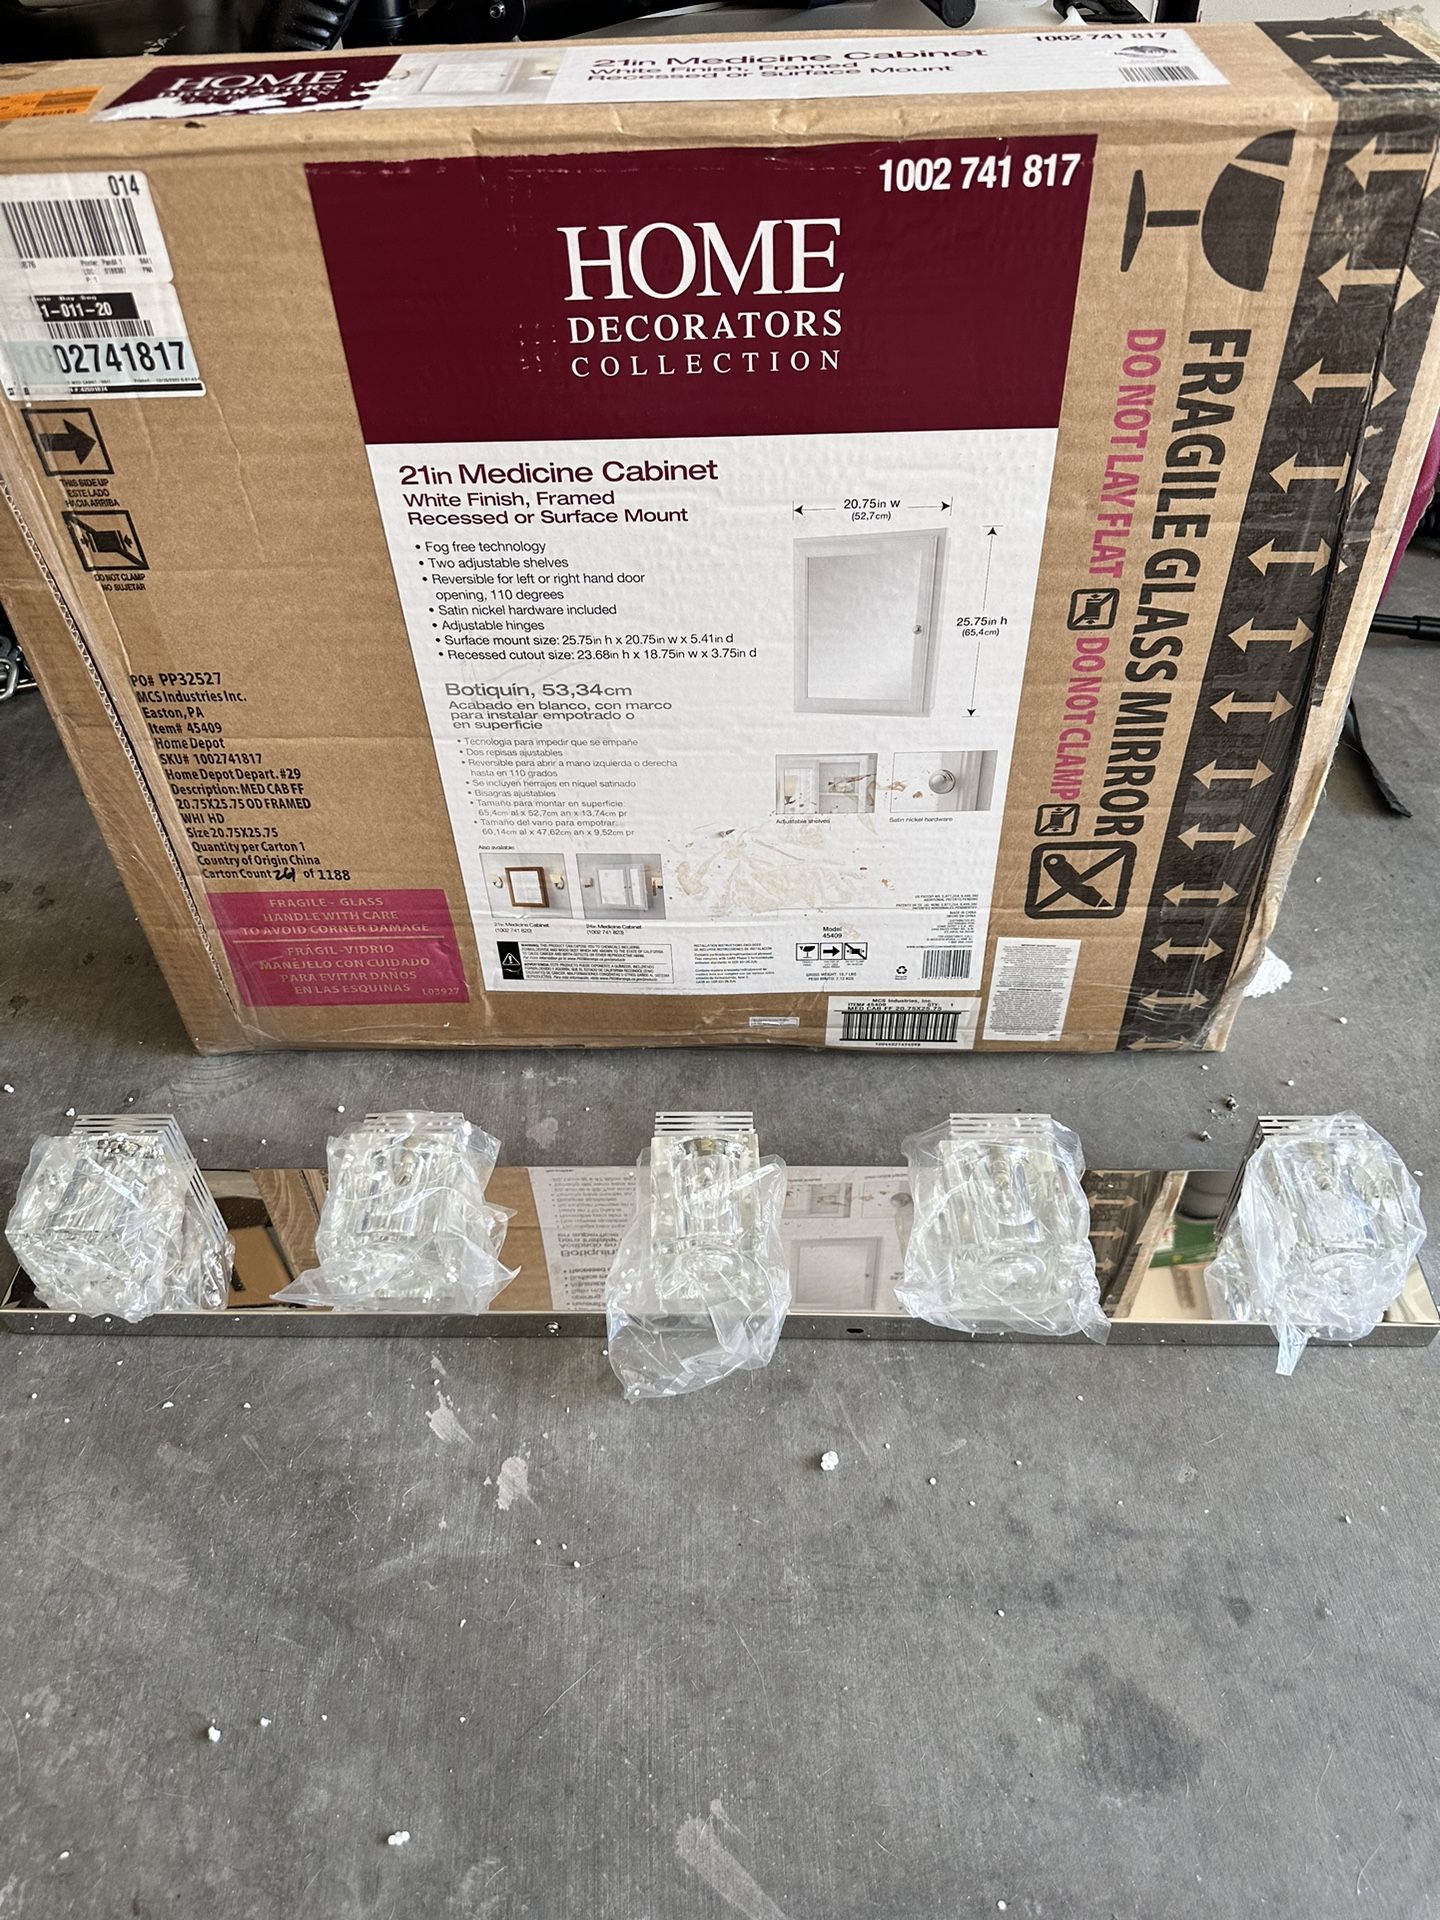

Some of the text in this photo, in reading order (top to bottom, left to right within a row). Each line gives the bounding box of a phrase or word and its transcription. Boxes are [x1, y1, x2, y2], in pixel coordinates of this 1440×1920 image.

[667, 55, 831, 64] Medicine
[844, 50, 987, 59] Cabinet
[169, 70, 347, 90] HOME
[880, 154, 1080, 191] 1002 741 817
[108, 175, 139, 196] 014
[557, 218, 844, 300] HOME
[568, 310, 841, 343] DECORATORS
[572, 350, 839, 376] COLLECTION
[1088, 329, 1167, 580] DO NOT LAY FLAT
[400, 460, 718, 484] 21in Medicine Cabinet
[403, 490, 614, 508] White Finish, Framed
[844, 499, 886, 509] 20.75in
[408, 508, 688, 525] Recessed or Surface Mount
[852, 512, 891, 522] (52,7cm)
[425, 541, 546, 555] Fog free technology
[428, 557, 568, 570] Two adjustable shelves
[432, 574, 494, 584] Reversible
[497, 574, 513, 584] for
[516, 573, 534, 584] left
[554, 574, 580, 586] right
[583, 573, 613, 583] hand
[617, 573, 645, 583] door
[1093, 329, 1252, 839] FRAGILE GLASS MIRROR
[436, 589, 564, 602] opening, 110 degrees
[438, 604, 616, 615] Satin nickel hardware included
[442, 620, 544, 632] Adjustable hinges
[957, 617, 996, 626] 25.75in
[962, 628, 999, 637] (65,4cm)
[445, 635, 489, 645] Surface
[493, 636, 530, 645] mount
[562, 635, 601, 645] 25.75in
[605, 635, 612, 644] h
[626, 634, 665, 644] 20.75in
[691, 634, 723, 644] 5.41in
[726, 633, 733, 643] d
[130, 672, 220, 686] PO# PP32527
[136, 690, 246, 702] MCS Industries Inc.
[446, 683, 632, 699] Botiquín, 53,34cm
[449, 701, 512, 710] Acabado
[539, 701, 590, 710] blanco,
[142, 707, 204, 719] Easton, PA
[451, 712, 484, 720] para
[488, 711, 538, 719] instalar
[543, 711, 621, 721] empotrado
[1052, 636, 1110, 800] DO NOT CLAMP
[148, 722, 222, 734] Item# 45409
[475, 720, 542, 730] superficie
[154, 738, 225, 751] Home Depot
[536, 739, 568, 747] impedir
[159, 753, 261, 764] SKU# 1002741817
[180, 813, 224, 824] WHI HD
[197, 855, 320, 868] Country of Origin China
[202, 869, 238, 878] Carton
[239, 869, 272, 878] Count
[303, 868, 314, 878] of
[318, 870, 350, 880] 1188
[270, 898, 327, 907] FRAGILE
[340, 898, 383, 906] GLASS
[264, 911, 398, 921] HANDLE WITH CARE
[262, 926, 310, 935] AVOID
[310, 925, 366, 934] CORNER
[367, 958, 430, 967] CUIDADO
